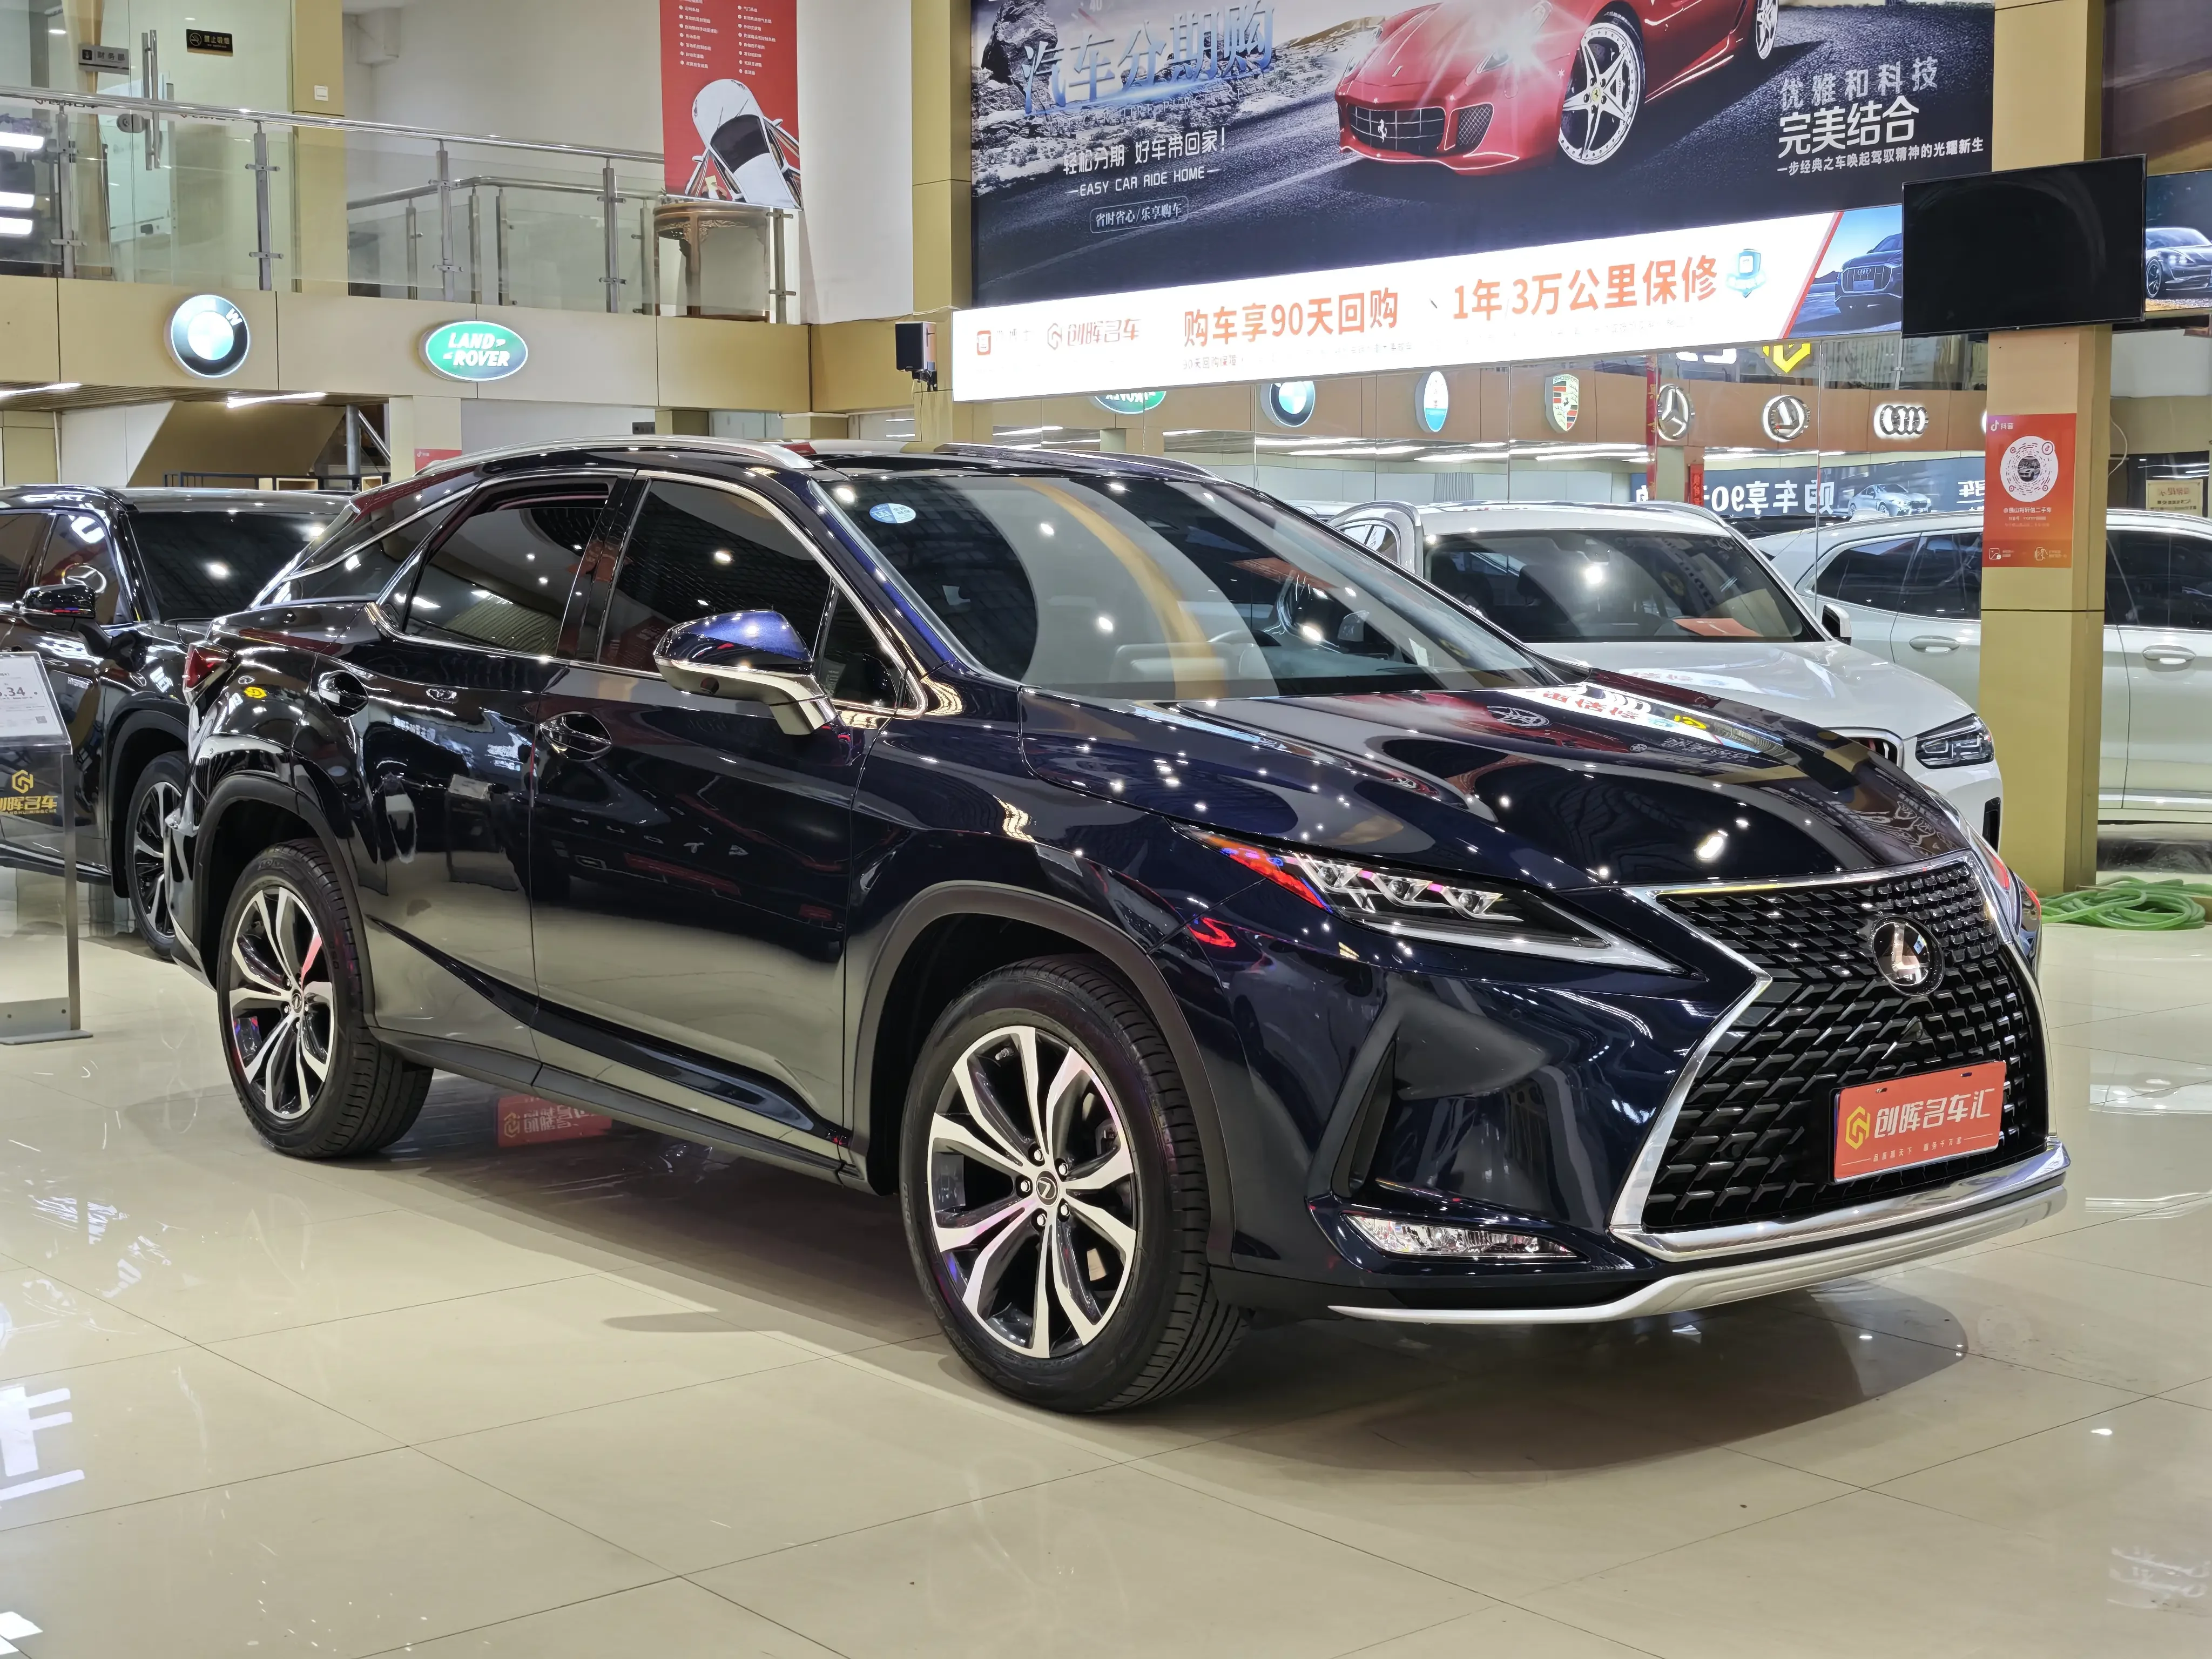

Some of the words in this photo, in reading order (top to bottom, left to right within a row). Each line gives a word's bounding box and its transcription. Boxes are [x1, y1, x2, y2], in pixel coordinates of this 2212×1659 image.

[1022, 0, 1276, 114] 汽车分期购
[1782, 56, 1938, 111] 优雅和科技
[1778, 95, 1919, 159] 完美结合
[1063, 144, 1125, 175] 轻松分期
[1080, 181, 1109, 197] EASY
[1115, 177, 1137, 191] CAR
[1143, 172, 1168, 187] RIDE
[1174, 166, 1205, 183] HOME
[1096, 203, 1182, 227] 省时省心/乐享购车
[1184, 287, 1399, 347] 购车享90天回购
[448, 332, 496, 349] LAND
[453, 349, 511, 367] ROVER
[1874, 1088, 1995, 1138] 创晖名车汇
